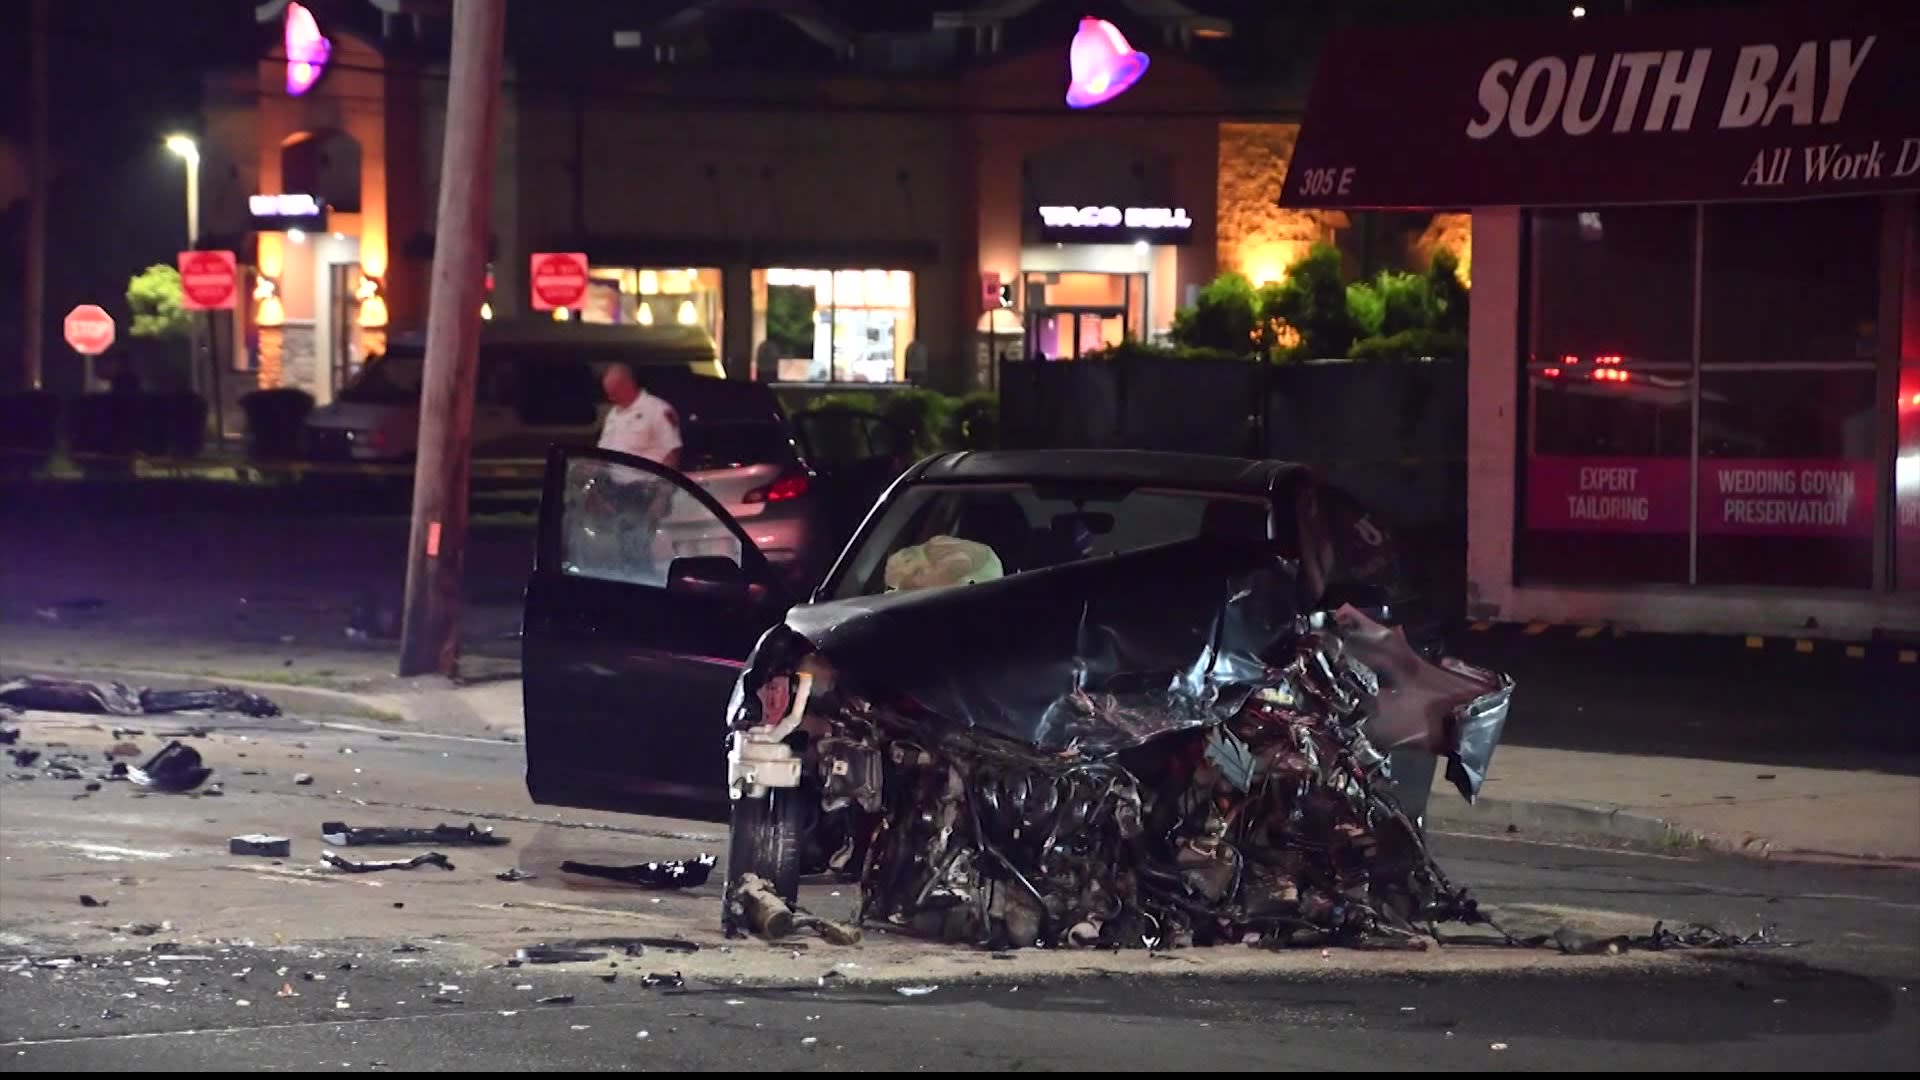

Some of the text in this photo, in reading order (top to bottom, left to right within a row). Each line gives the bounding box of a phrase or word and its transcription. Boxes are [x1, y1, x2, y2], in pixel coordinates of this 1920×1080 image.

[1466, 35, 1877, 139] SOUTH BAY
[1741, 147, 1793, 186] All
[1803, 141, 1887, 184] Work
[1299, 167, 1357, 196] 305 E
[1580, 467, 1638, 491] EXPERT
[1718, 470, 1855, 495] WEDDING GOWN
[1568, 496, 1649, 521] TAILORING
[1723, 498, 1849, 526] PRESERVATION
